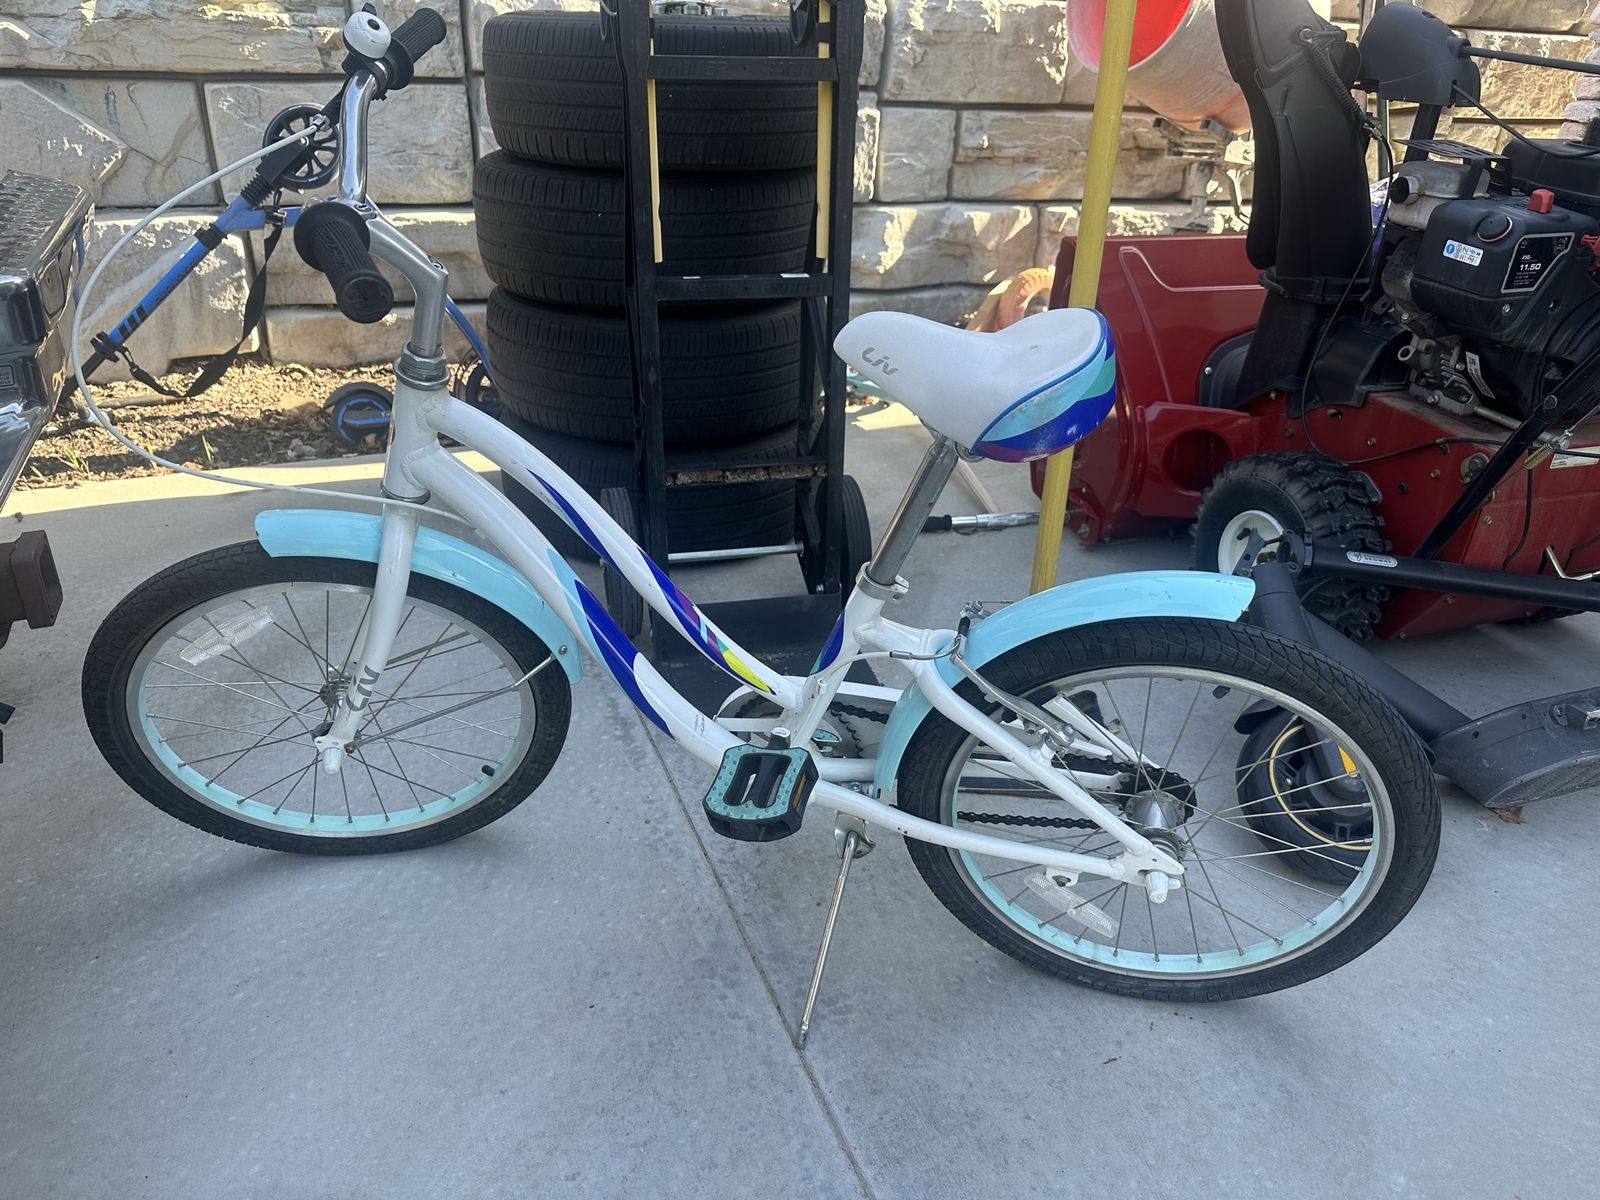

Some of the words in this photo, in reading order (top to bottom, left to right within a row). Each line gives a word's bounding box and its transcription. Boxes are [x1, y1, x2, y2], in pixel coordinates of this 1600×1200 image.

[1520, 263, 1542, 271] 11.50
[862, 346, 899, 376] Liv
[346, 664, 380, 712] Liv
